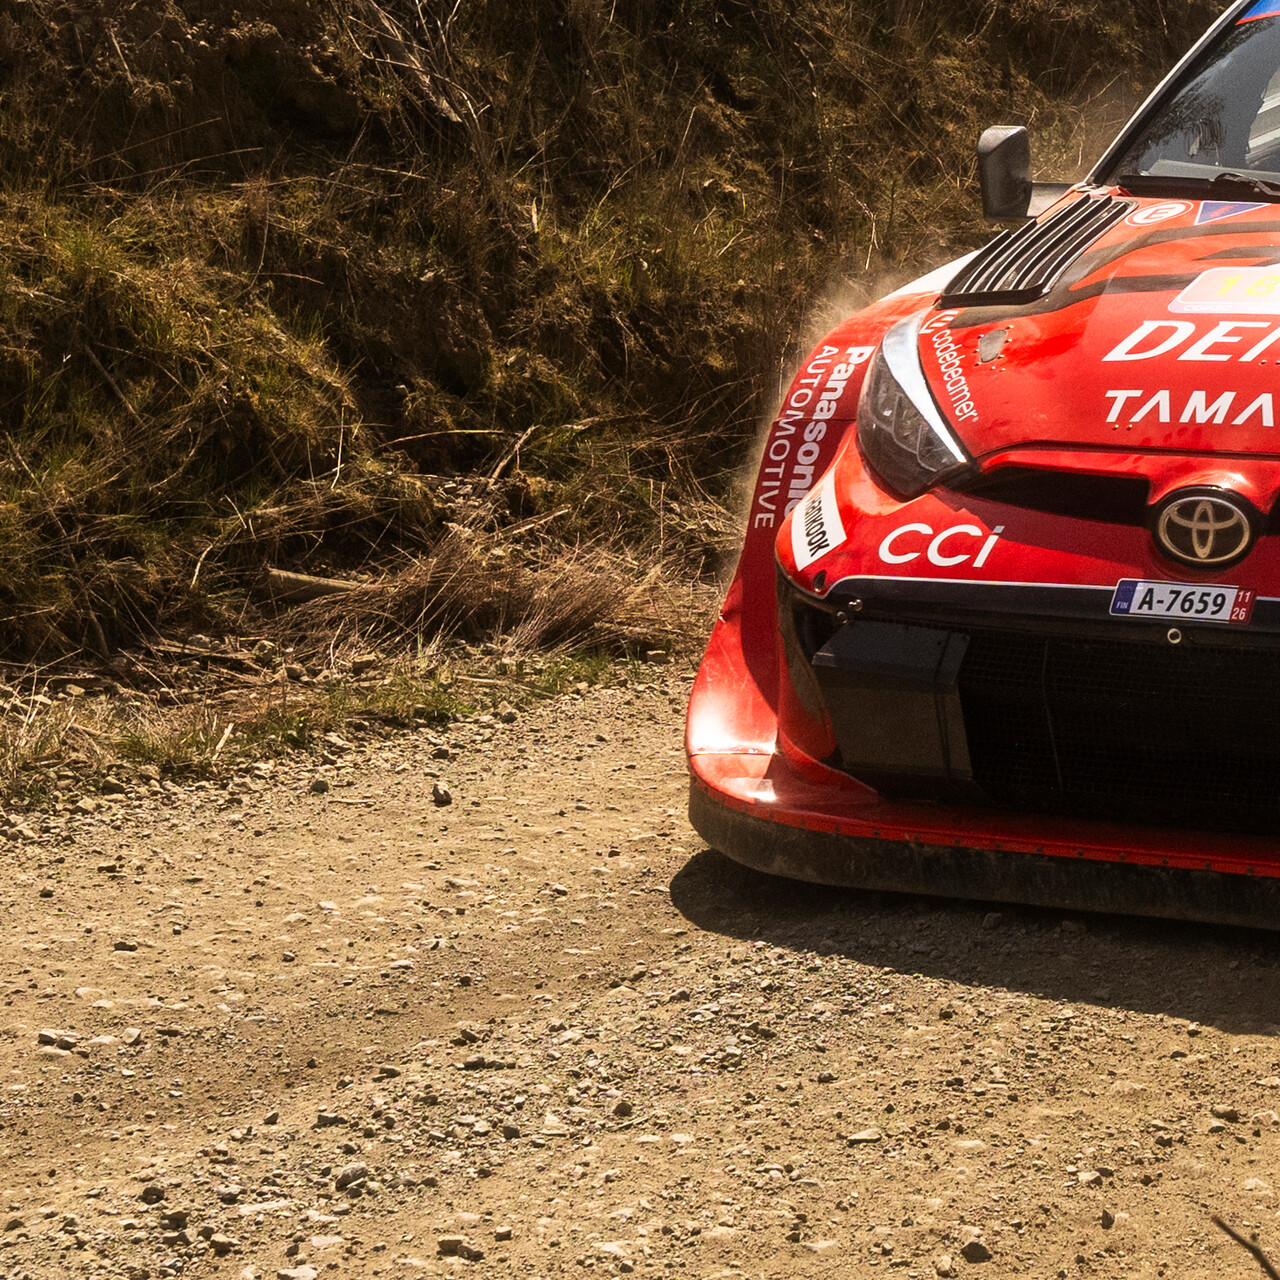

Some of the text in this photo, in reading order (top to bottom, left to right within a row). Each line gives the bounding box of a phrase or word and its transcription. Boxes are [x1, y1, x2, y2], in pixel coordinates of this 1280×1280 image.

[754, 344, 839, 529] AUTOMOTIVE
[1116, 588, 1226, 615] FIN A-7659
[1238, 590, 1251, 603] 11
[1231, 607, 1246, 620] 26
